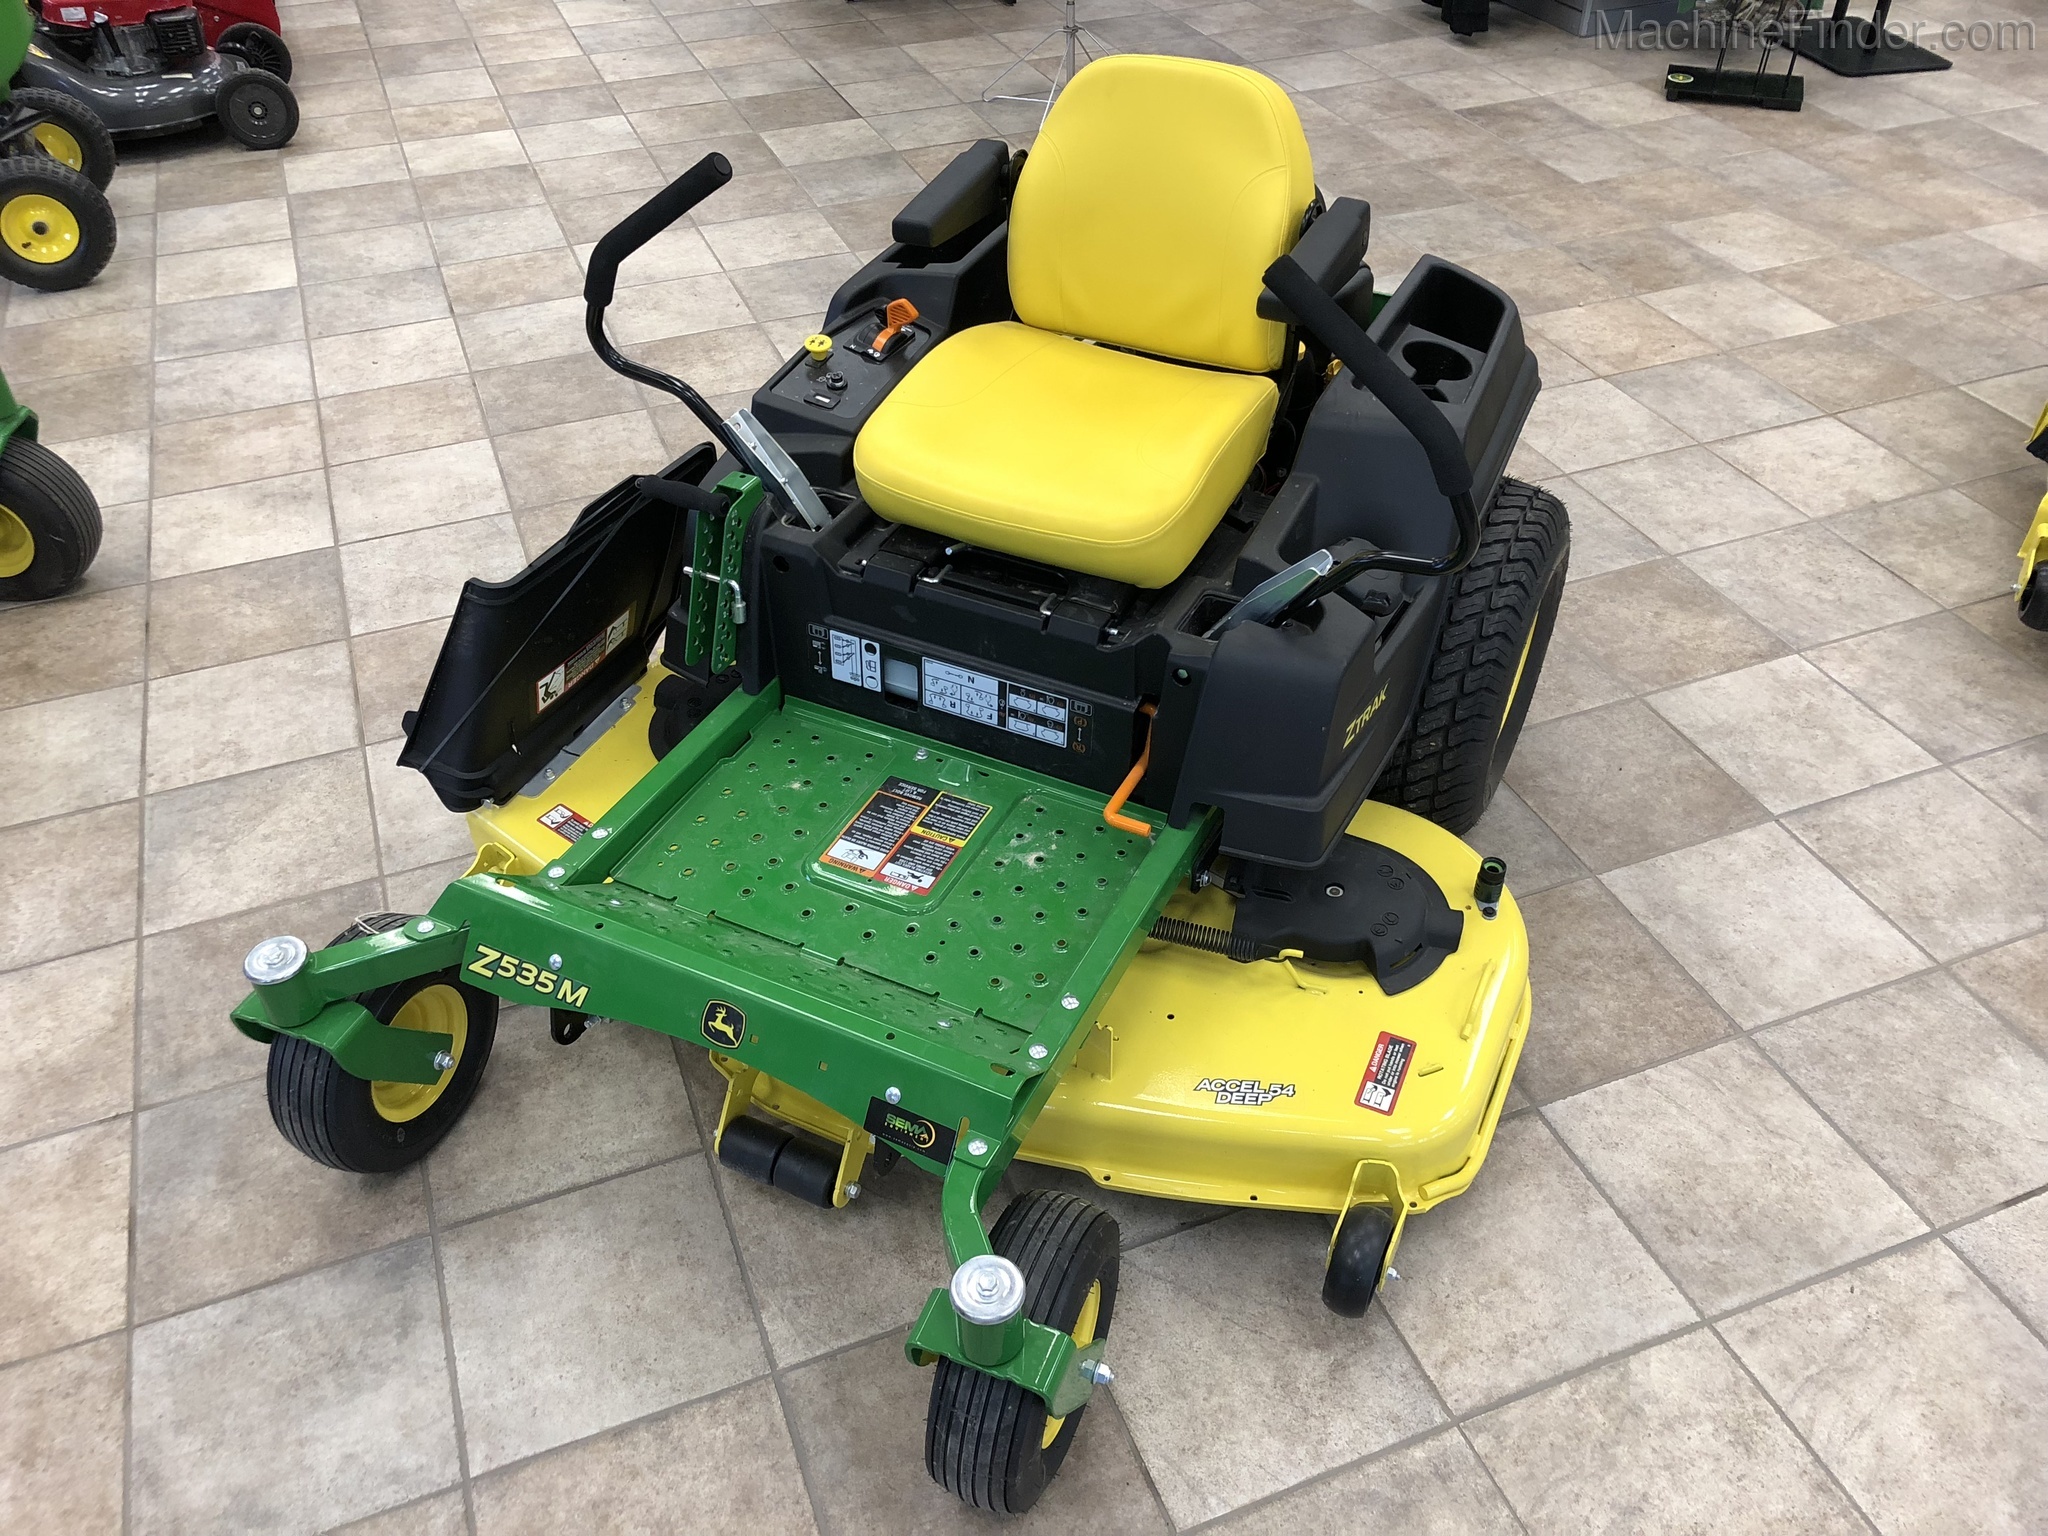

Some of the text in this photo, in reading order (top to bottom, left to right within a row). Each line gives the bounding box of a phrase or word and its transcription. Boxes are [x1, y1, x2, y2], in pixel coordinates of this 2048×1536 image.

[567, 664, 594, 688] DANGER
[1343, 682, 1389, 750] ZTRAK
[920, 829, 948, 840] CAUTION
[827, 858, 859, 870] WARNING
[883, 876, 912, 890] DANGER
[1371, 1043, 1384, 1065] DANGER
[1194, 1078, 1296, 1098] ACCEL 54
[1214, 1091, 1273, 1106] DEEP
